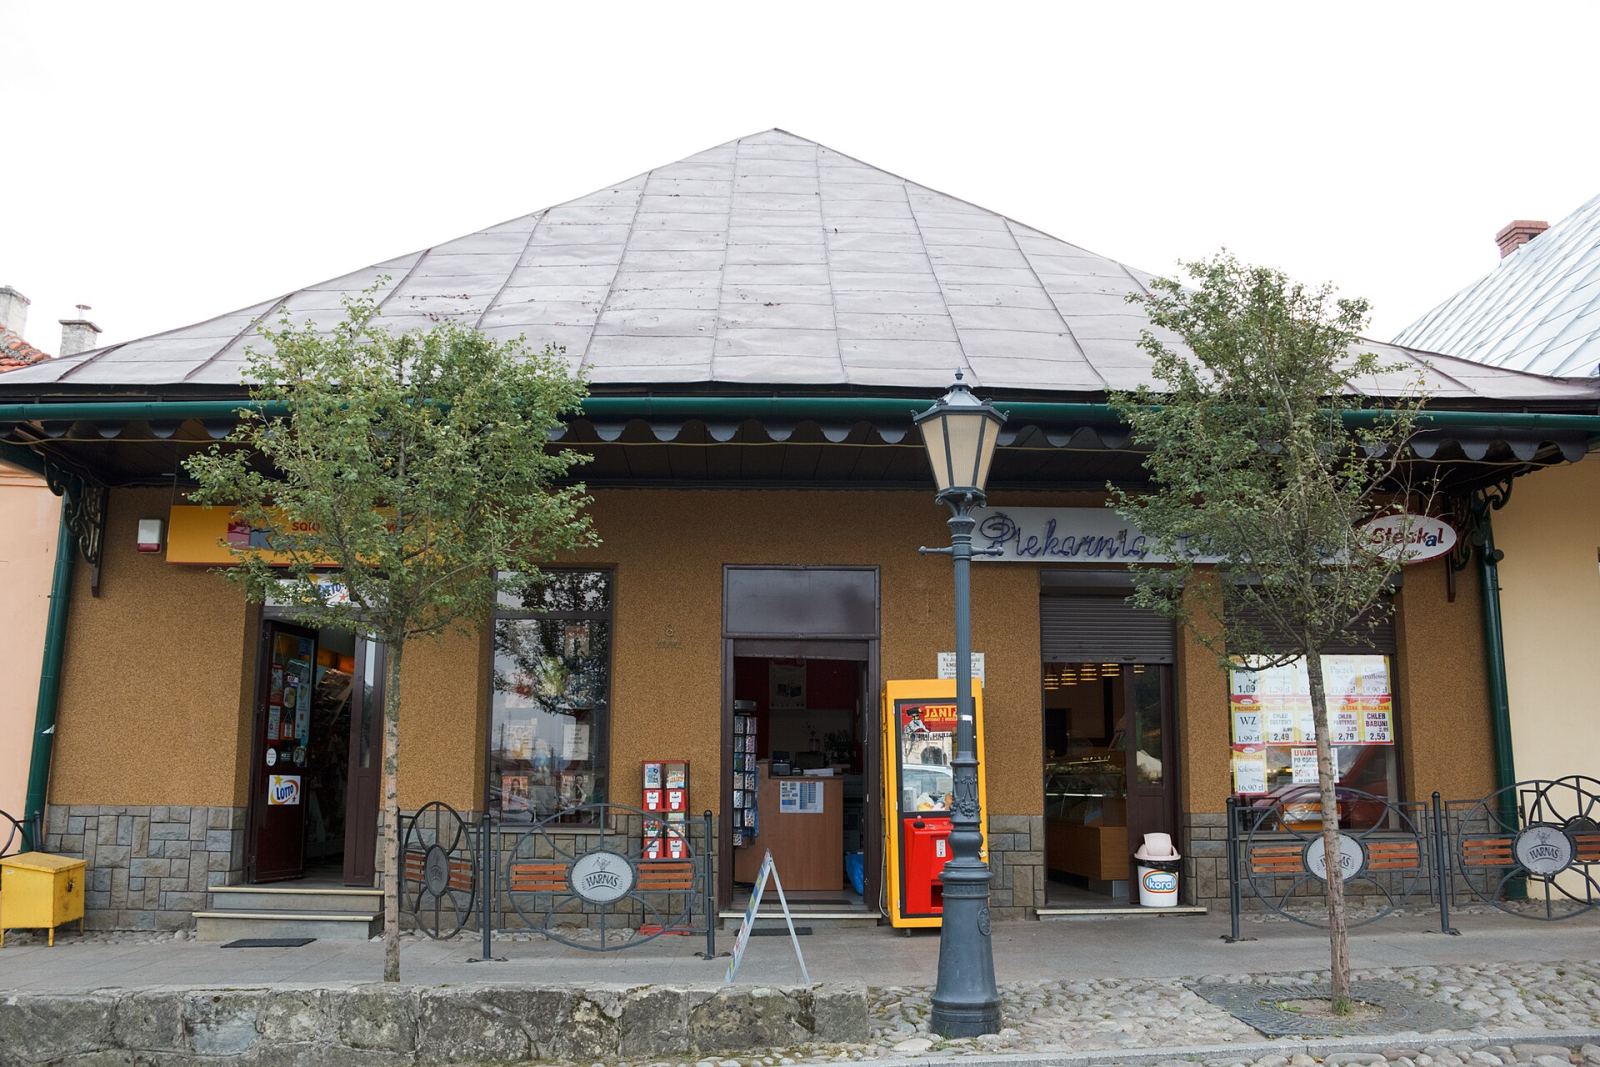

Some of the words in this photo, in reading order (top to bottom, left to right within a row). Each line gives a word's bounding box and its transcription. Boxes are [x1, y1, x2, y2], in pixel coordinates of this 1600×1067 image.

[1238, 684, 1256, 694] 1,09
[1366, 712, 1386, 720] CHLEB
[1240, 716, 1257, 725] WZ
[1273, 733, 1290, 741] 2,49
[1338, 733, 1355, 741] 2,79
[1369, 733, 1386, 741] 2,59
[276, 785, 294, 800] LOTTO
[1149, 877, 1175, 889] koral
